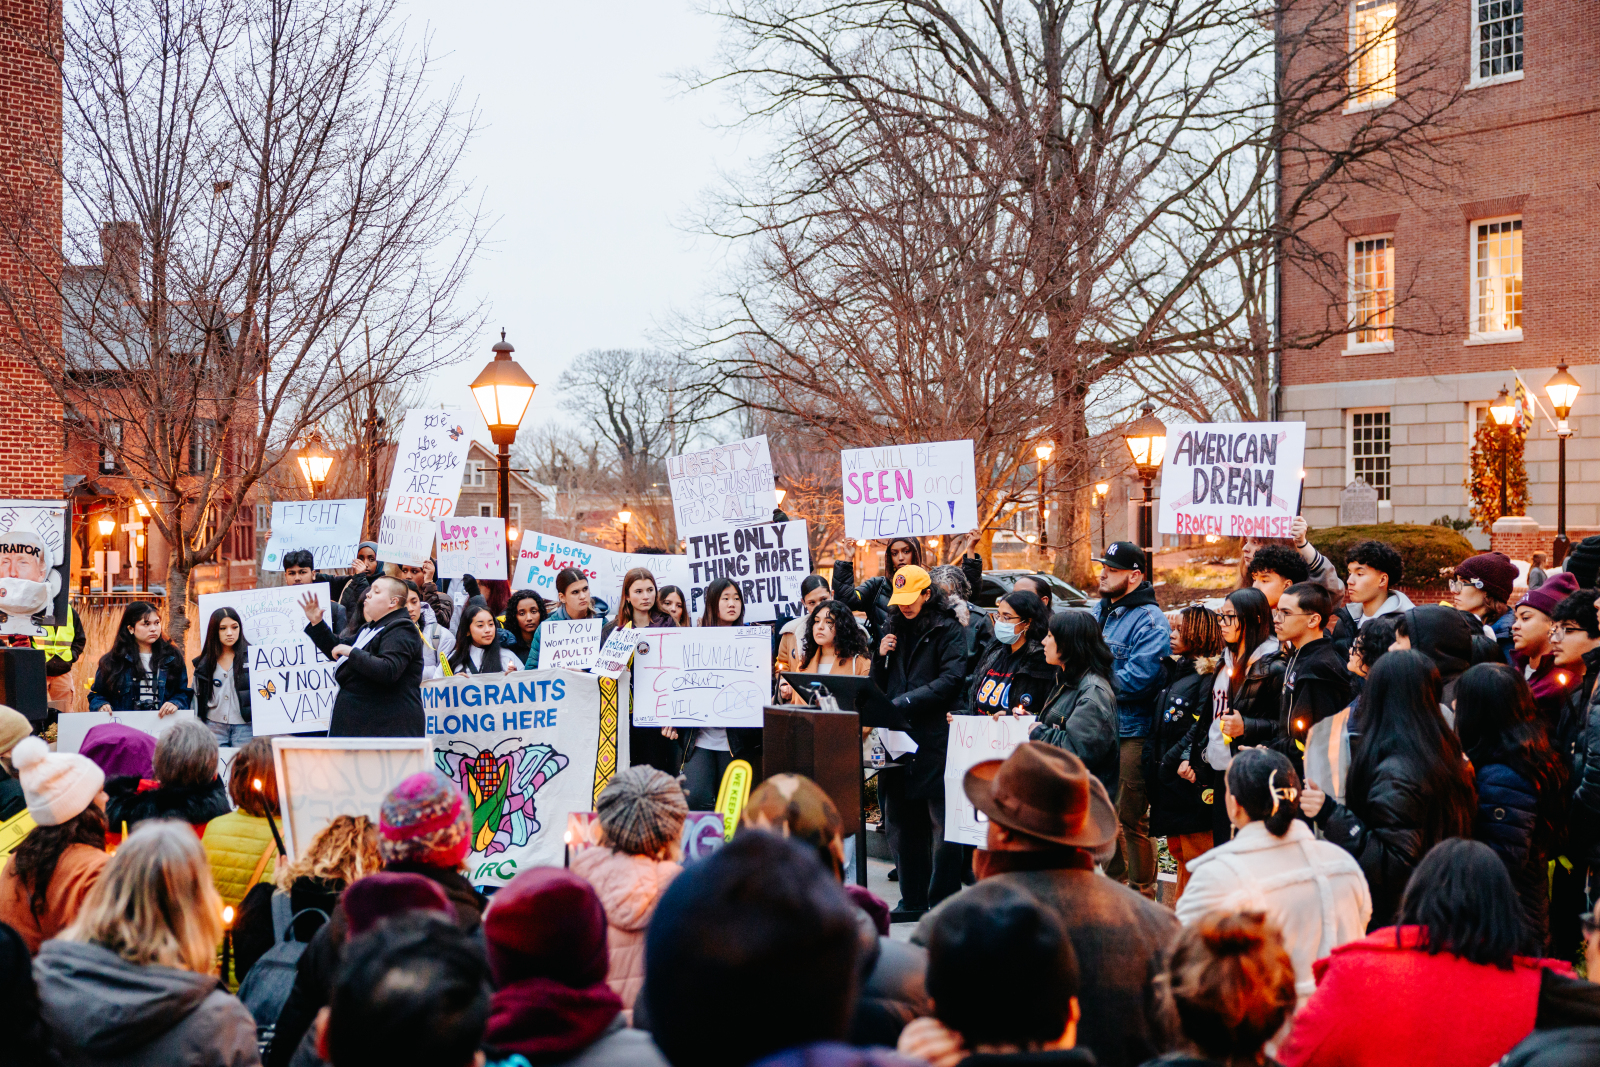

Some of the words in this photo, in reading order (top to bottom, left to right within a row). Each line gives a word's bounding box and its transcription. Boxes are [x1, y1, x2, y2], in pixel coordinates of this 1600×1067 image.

[843, 451, 867, 470] WE
[871, 448, 908, 469] WILL
[916, 446, 938, 467] BE
[1172, 430, 1278, 466] AMERICAN
[668, 442, 761, 480] LIBERTY
[406, 474, 443, 495] ARE
[675, 475, 716, 500] AND
[717, 463, 775, 494] JUSTICE
[846, 469, 913, 504] SEEN
[924, 461, 964, 495] and
[1192, 465, 1274, 507] DREAM
[283, 504, 346, 525] FIGHT
[395, 495, 453, 518] PISSED
[680, 494, 720, 527] FOR
[30, 509, 63, 552] FELON
[381, 515, 396, 529] NO
[399, 520, 426, 535] HATE
[1176, 513, 1223, 535] BROKEN
[380, 530, 394, 545] NO
[395, 534, 423, 550] FEAR
[535, 535, 592, 565] Liberty
[689, 532, 731, 559] THE
[734, 524, 787, 553] ONLY
[521, 549, 539, 559] and
[689, 554, 750, 583] THING
[755, 547, 804, 574] MORE
[235, 597, 295, 615] GNORANCE
[240, 589, 284, 604] FIGHT
[253, 615, 279, 628] NOT
[548, 623, 559, 635] IF
[567, 622, 592, 634] YOU
[570, 636, 586, 644] ACT
[255, 644, 306, 671] AQUI
[552, 646, 594, 661] ADULTS
[278, 671, 290, 693] Y
[420, 678, 566, 709] MMIGRANTS
[426, 713, 495, 735] ELONG
[503, 708, 558, 731] HERE
[955, 721, 973, 749] No
[732, 772, 742, 788] WE
[728, 789, 738, 815] KEEP
[474, 858, 518, 880] IRC
